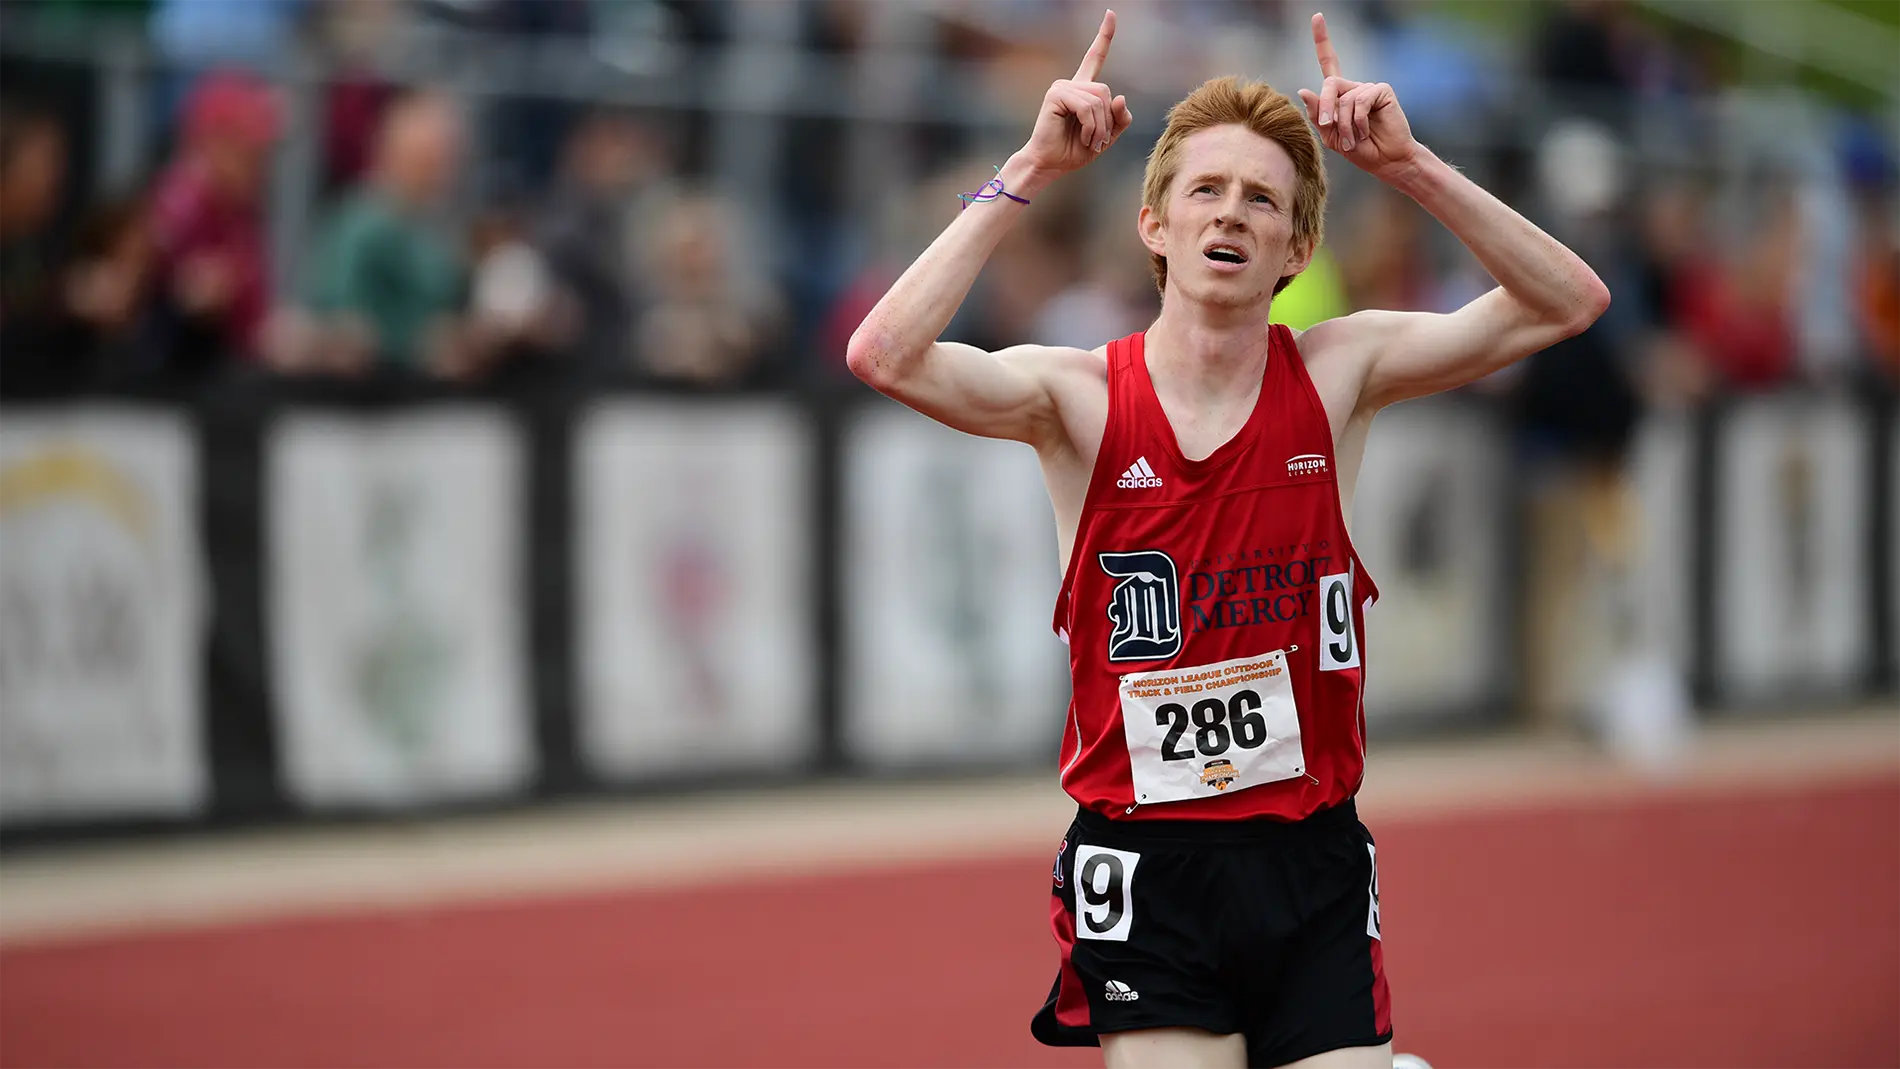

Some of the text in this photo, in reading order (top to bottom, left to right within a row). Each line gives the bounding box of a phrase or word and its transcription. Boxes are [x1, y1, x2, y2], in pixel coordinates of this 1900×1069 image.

[1288, 459, 1326, 471] HORIZON
[1288, 467, 1327, 477] LEAGUE
[1116, 477, 1163, 489] adidas
[1190, 543, 1309, 570] UNIVERSITY
[1188, 556, 1332, 602] DETROIT
[1189, 589, 1313, 634] MERCY
[1326, 580, 1353, 663] 9
[1127, 667, 1282, 698] TRACK & FIELD CHAMPIONSHIP
[1133, 659, 1274, 688] HORIZON LEAGUE OUTDOOR
[1155, 689, 1267, 762] 286
[1081, 853, 1124, 934] 9
